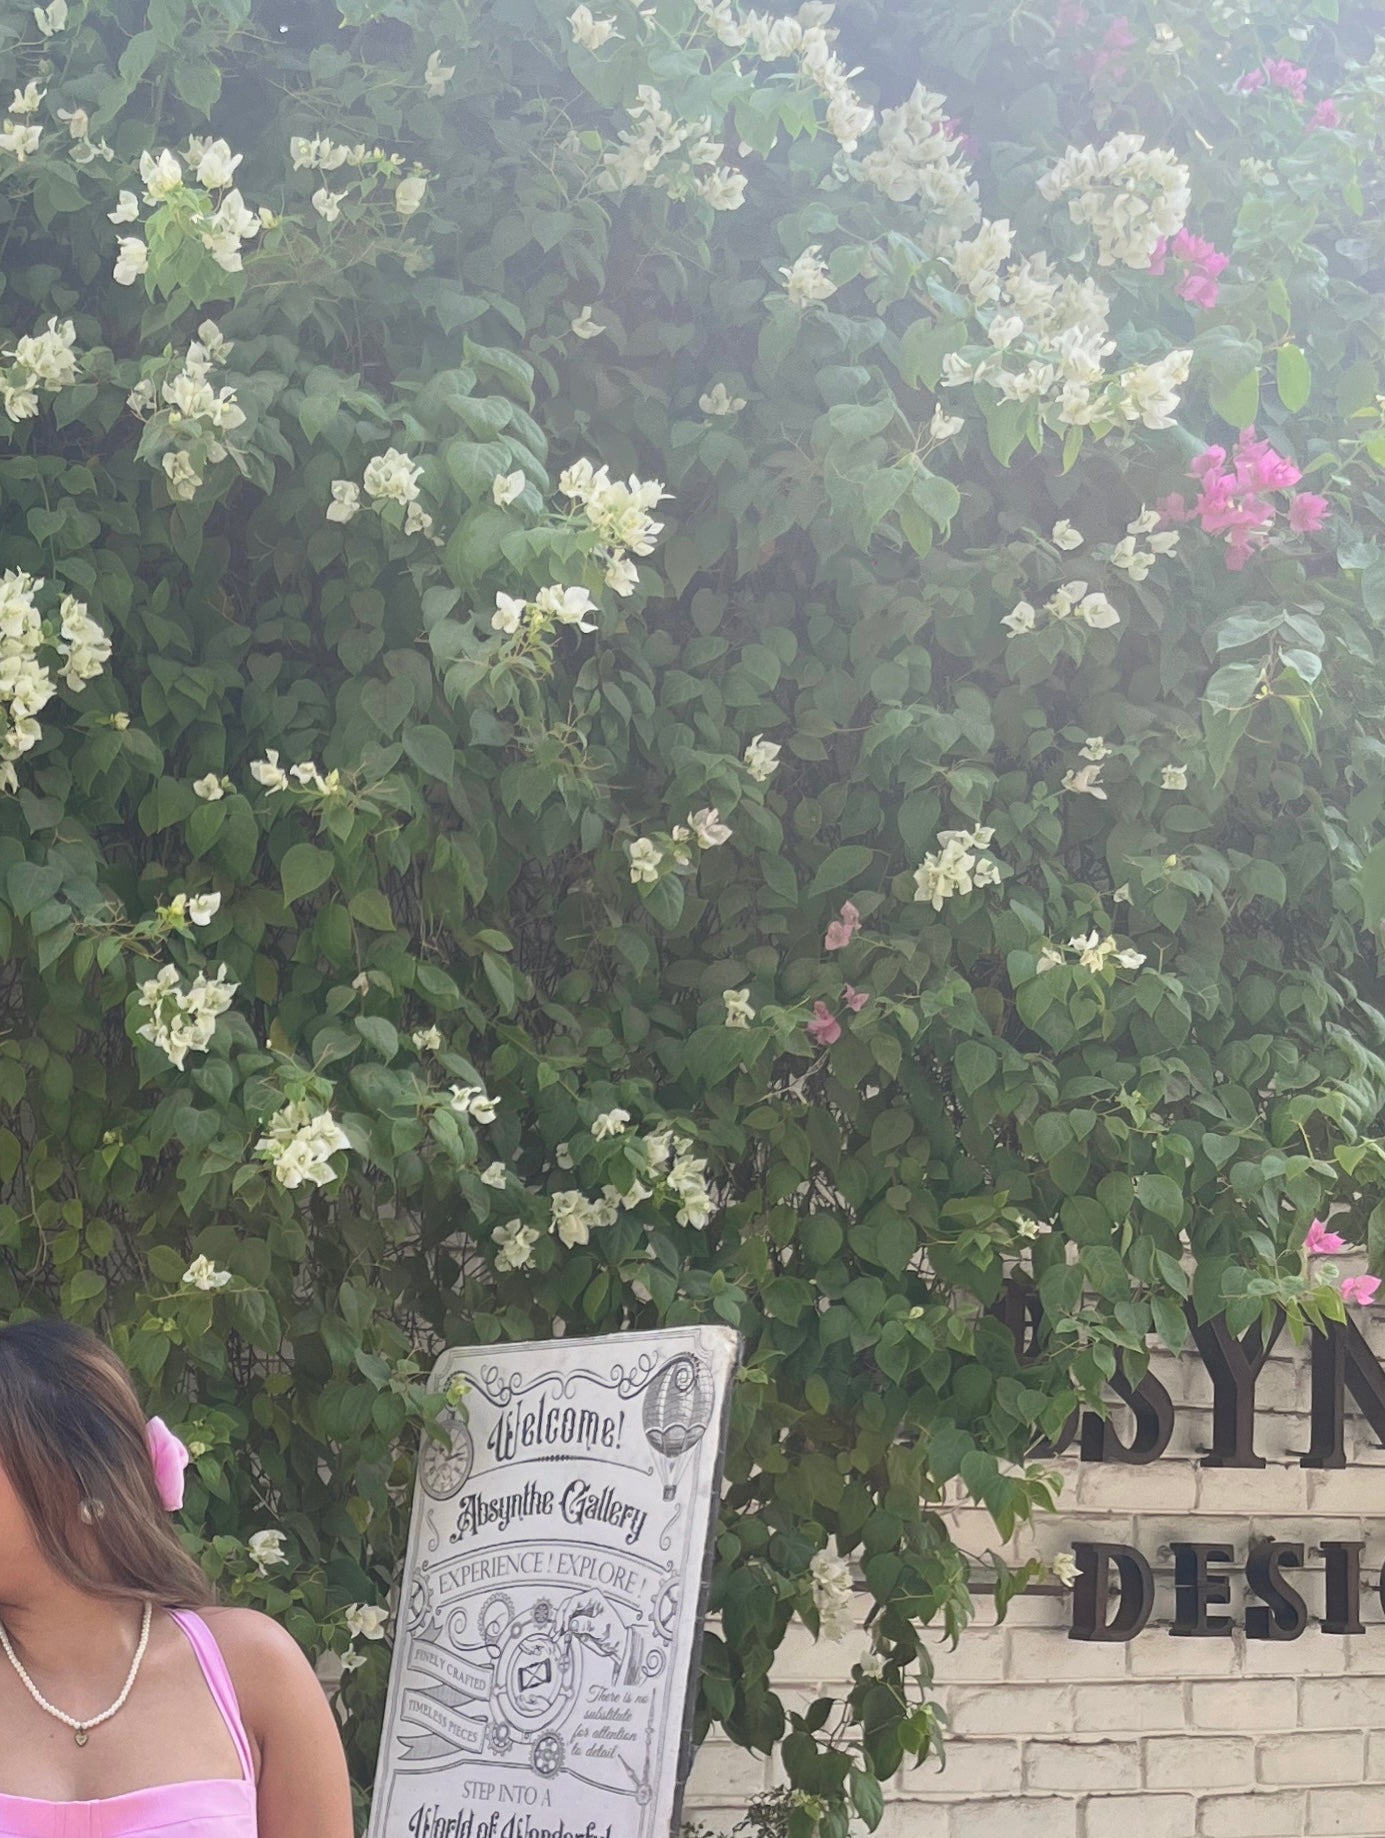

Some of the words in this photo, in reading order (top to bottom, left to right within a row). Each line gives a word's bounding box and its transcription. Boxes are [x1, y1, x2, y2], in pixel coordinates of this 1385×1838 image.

[487, 1392, 625, 1462] Welcome!
[449, 1480, 554, 1544] Absynthe
[559, 1479, 647, 1545] Gallery
[1068, 1541, 1385, 1642] DESI
[414, 1649, 446, 1670] FINELY
[446, 1663, 487, 1691] CRAFTED
[586, 1684, 621, 1704] There
[623, 1692, 632, 1704] is
[634, 1695, 649, 1704] no
[408, 1699, 447, 1728] TIMELESS
[447, 1721, 478, 1743] PIECES
[583, 1706, 633, 1721] substitute
[570, 1723, 589, 1744] for
[592, 1725, 637, 1741] attention
[571, 1742, 582, 1756] to
[585, 1742, 618, 1759] detail
[462, 1780, 495, 1801] STEP
[498, 1784, 538, 1806] INTO
[541, 1788, 552, 1808] A
